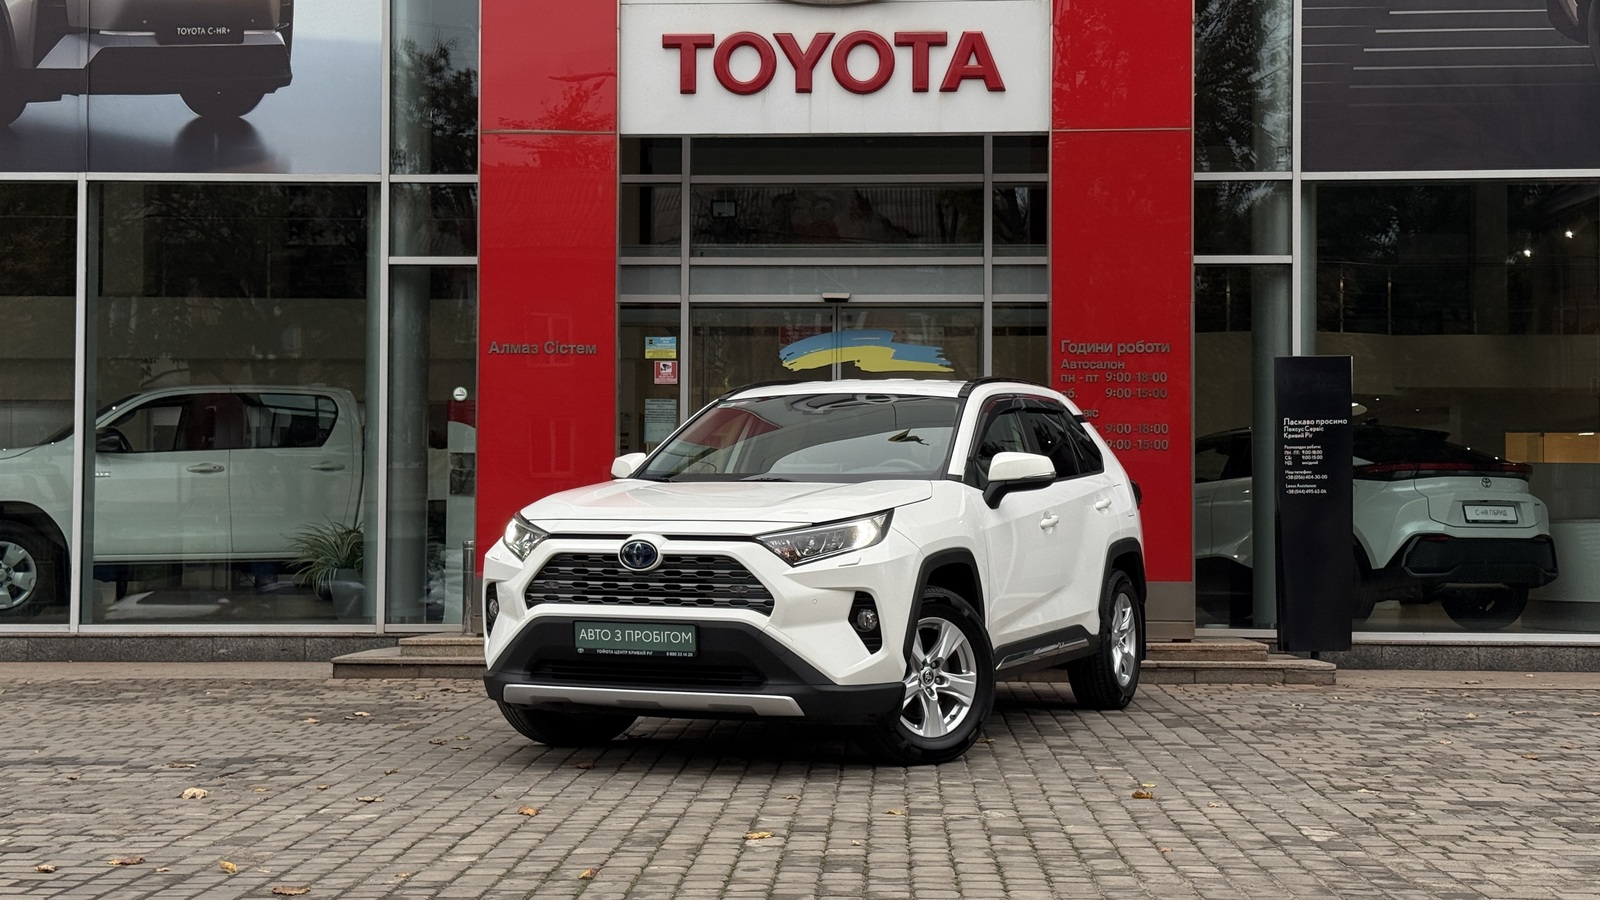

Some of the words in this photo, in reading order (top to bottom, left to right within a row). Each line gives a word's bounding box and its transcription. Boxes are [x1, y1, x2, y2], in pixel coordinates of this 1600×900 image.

[177, 27, 206, 35] TOYOTA
[662, 30, 1006, 95] TOYOTA
[488, 341, 539, 354] Алмаз
[543, 341, 597, 354] Сістем
[1061, 340, 1113, 355] Години
[1117, 340, 1171, 356] роботи
[1061, 359, 1125, 370] Автосалон
[1060, 374, 1075, 383] пн
[1085, 374, 1099, 383] пт
[579, 628, 611, 641] АВТО
[614, 629, 622, 642] З
[625, 630, 692, 644] ПРОБІГОМ
